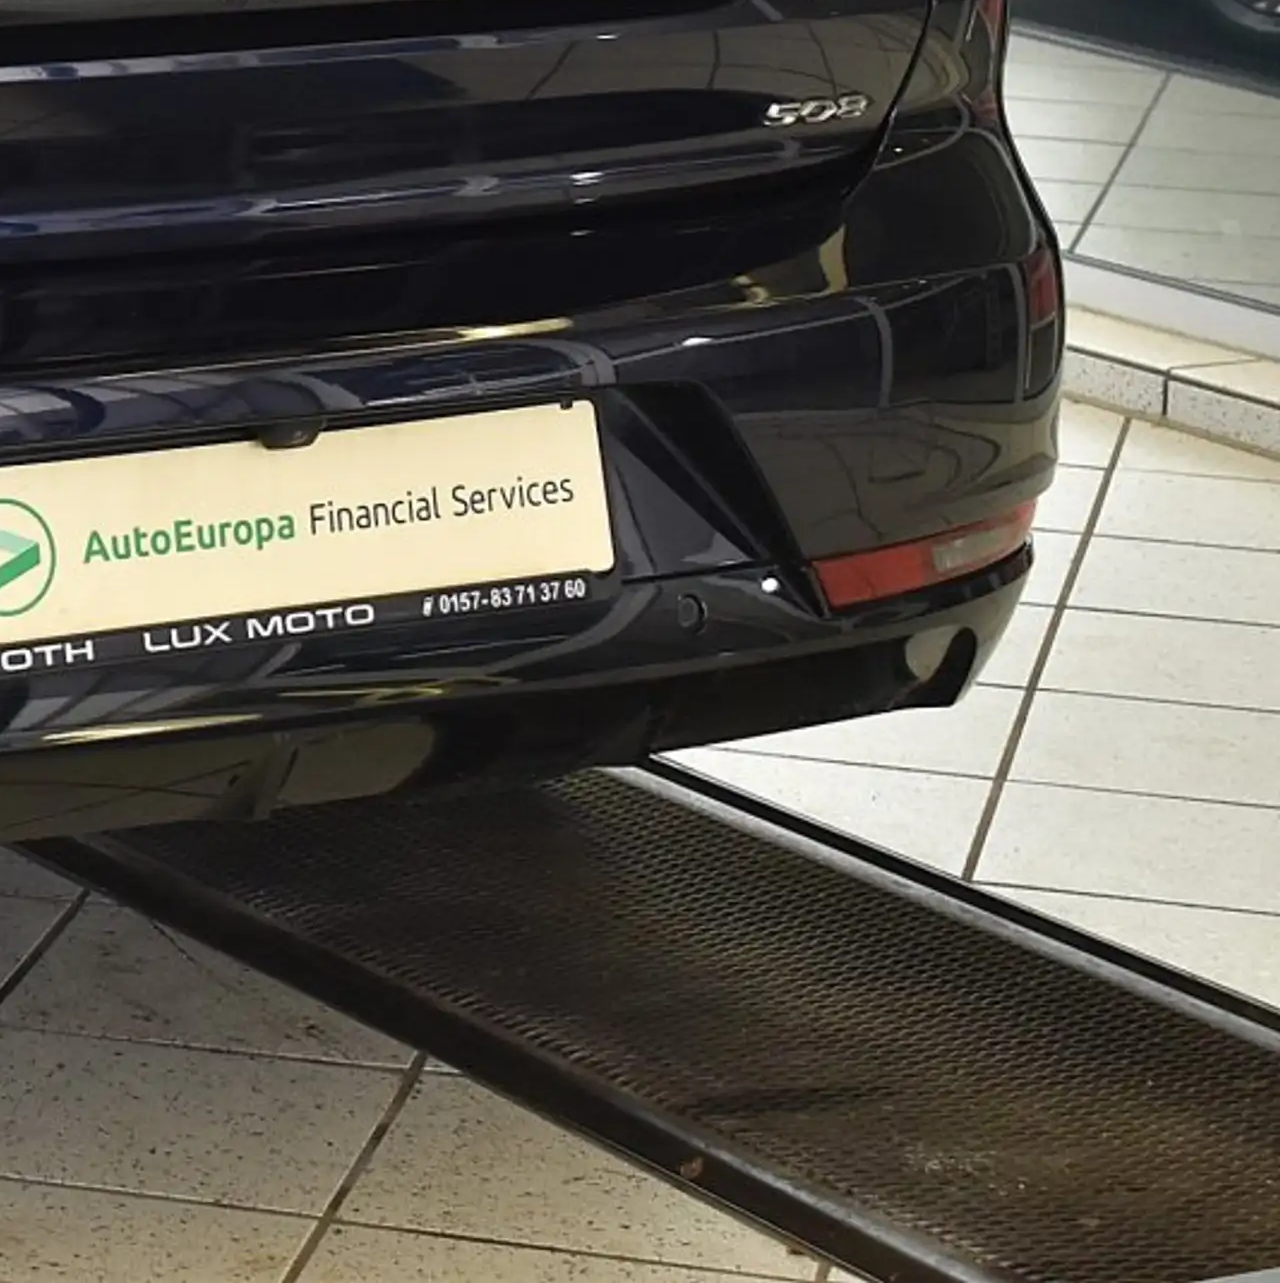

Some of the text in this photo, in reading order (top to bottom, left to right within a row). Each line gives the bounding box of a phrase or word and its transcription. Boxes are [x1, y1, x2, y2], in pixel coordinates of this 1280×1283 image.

[763, 95, 870, 125] 508
[83, 476, 575, 564] AutoEuropa Financial Services
[143, 620, 233, 653] LUX
[246, 604, 375, 640] MOTO
